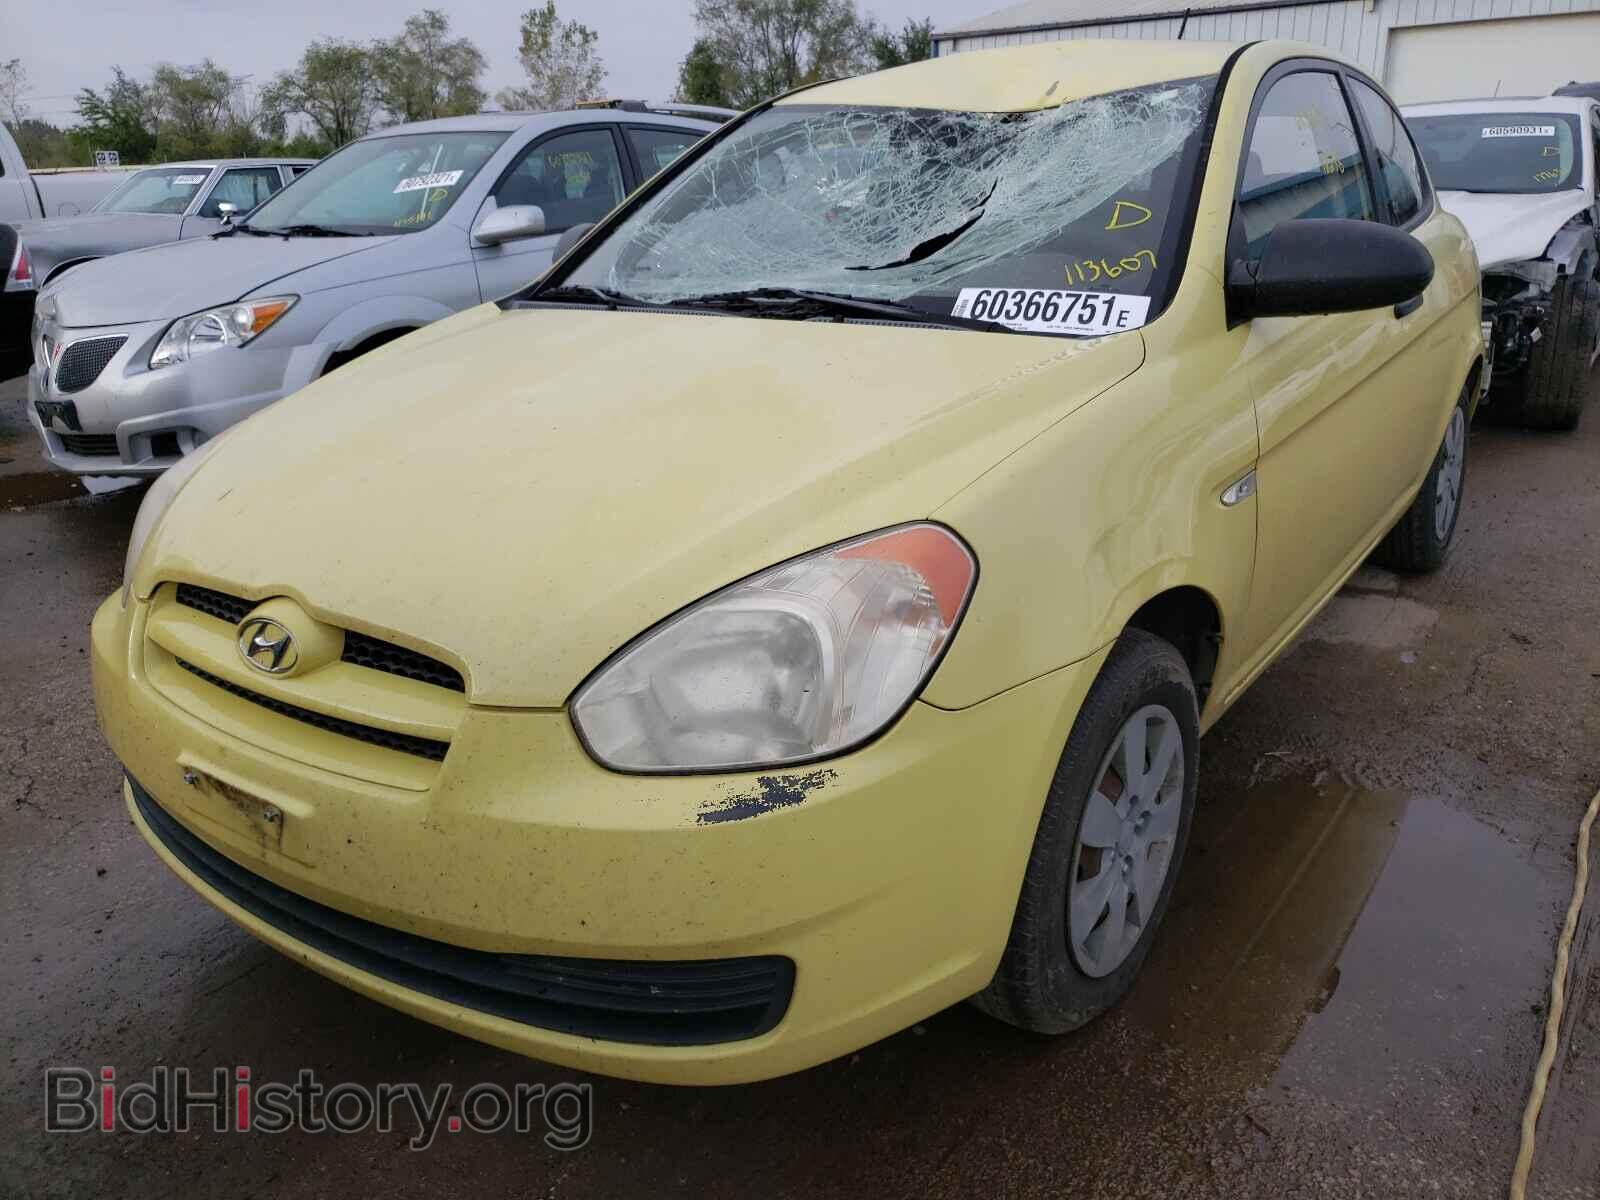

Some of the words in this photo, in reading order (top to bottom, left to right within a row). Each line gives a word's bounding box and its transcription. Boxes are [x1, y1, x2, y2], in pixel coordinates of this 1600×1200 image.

[1104, 200, 1152, 230] D
[1063, 249, 1158, 287] 113607
[969, 289, 1116, 328] 60366751
